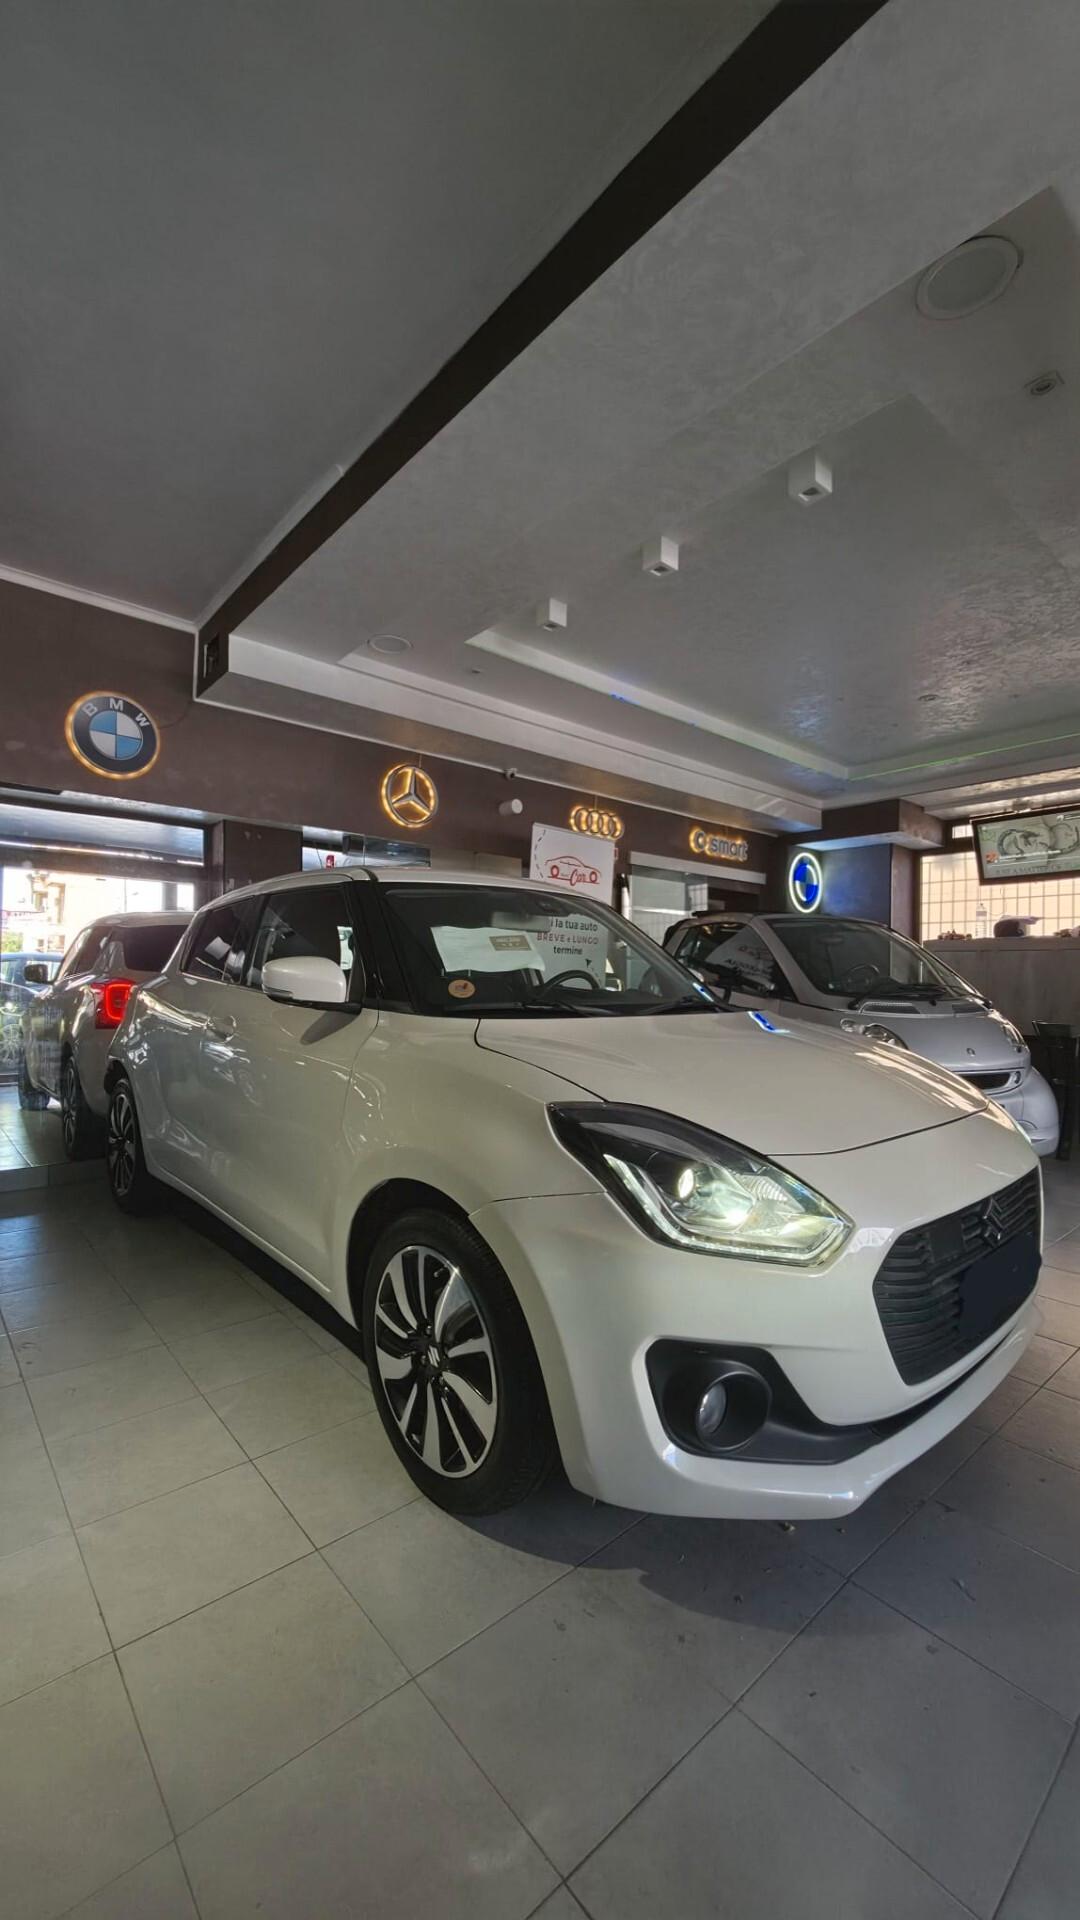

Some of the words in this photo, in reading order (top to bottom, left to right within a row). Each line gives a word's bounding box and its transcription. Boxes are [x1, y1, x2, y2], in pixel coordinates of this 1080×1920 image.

[82, 698, 150, 727] BMW
[711, 838, 749, 861] smart
[555, 918, 563, 928] la
[565, 920, 579, 929] tua
[580, 922, 598, 932] auto
[537, 932, 565, 942] BREVE
[553, 946, 583, 955] termine
